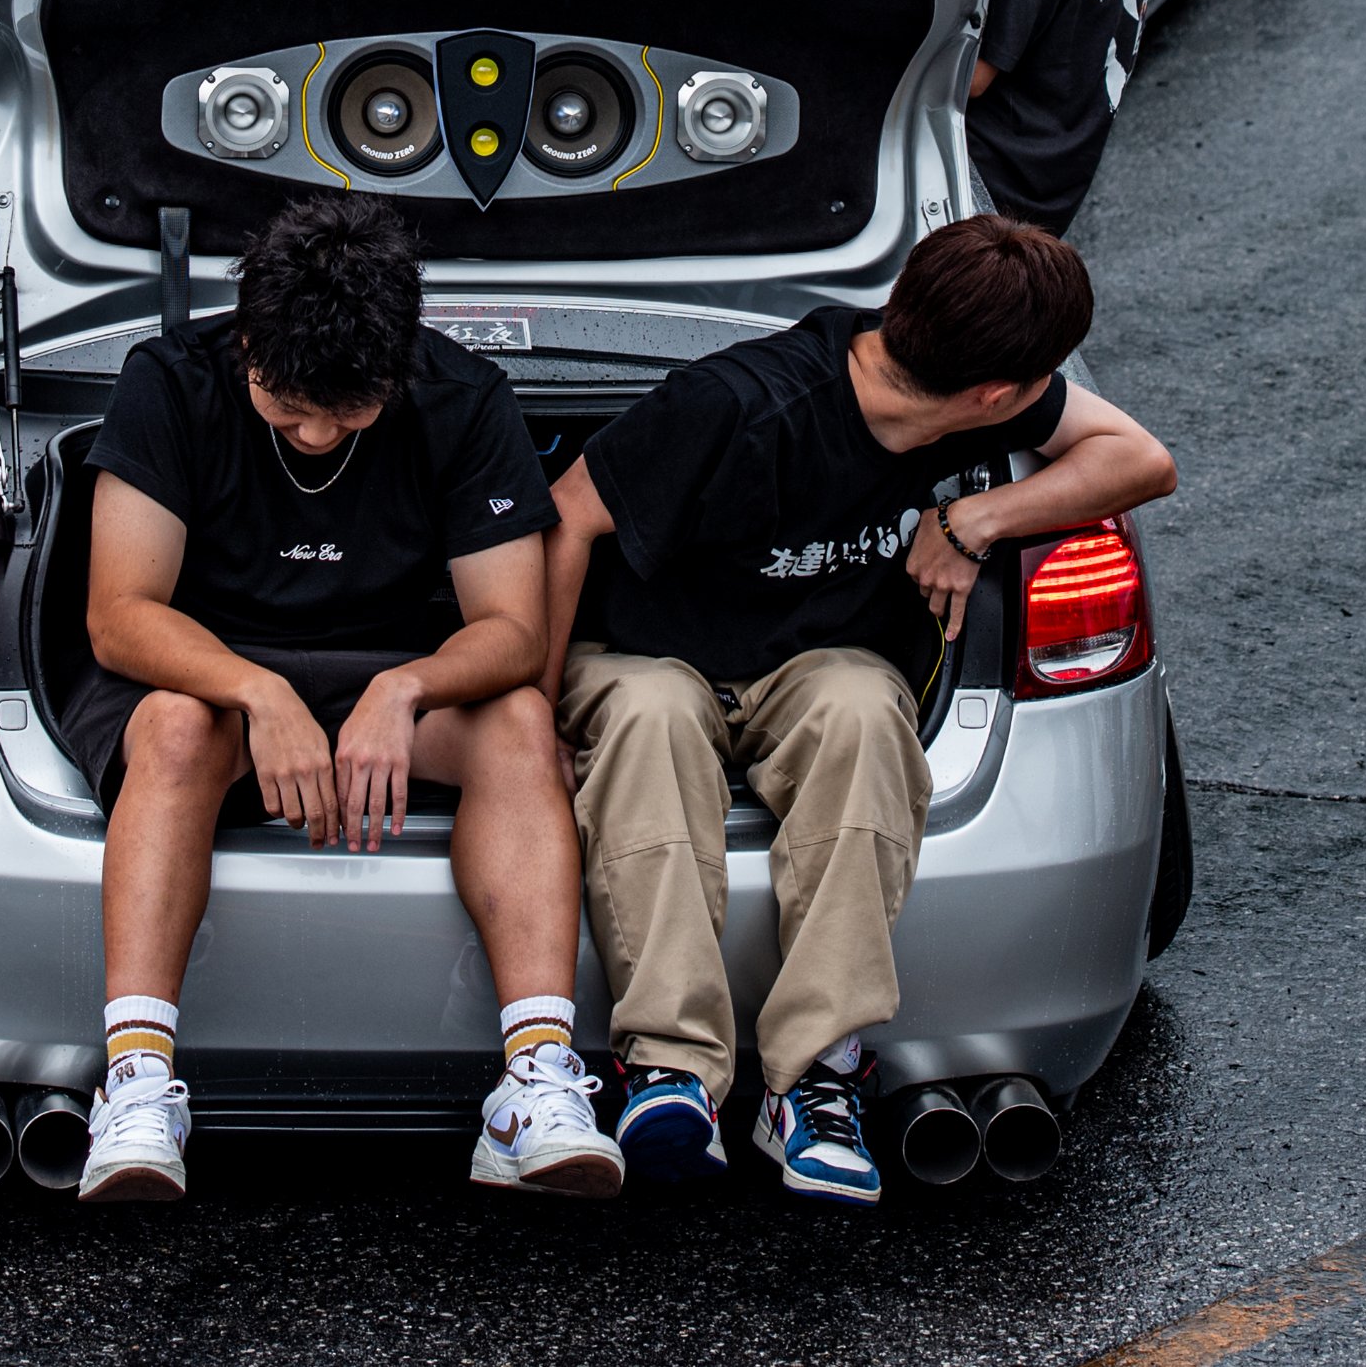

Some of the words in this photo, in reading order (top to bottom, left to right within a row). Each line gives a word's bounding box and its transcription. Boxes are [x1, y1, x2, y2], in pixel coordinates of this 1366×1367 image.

[360, 144, 394, 160] GROUND
[394, 144, 415, 159] ZERO
[542, 144, 576, 160] GROUND
[576, 144, 598, 159] ZERO
[280, 544, 317, 560] New
[318, 543, 343, 561] Era
